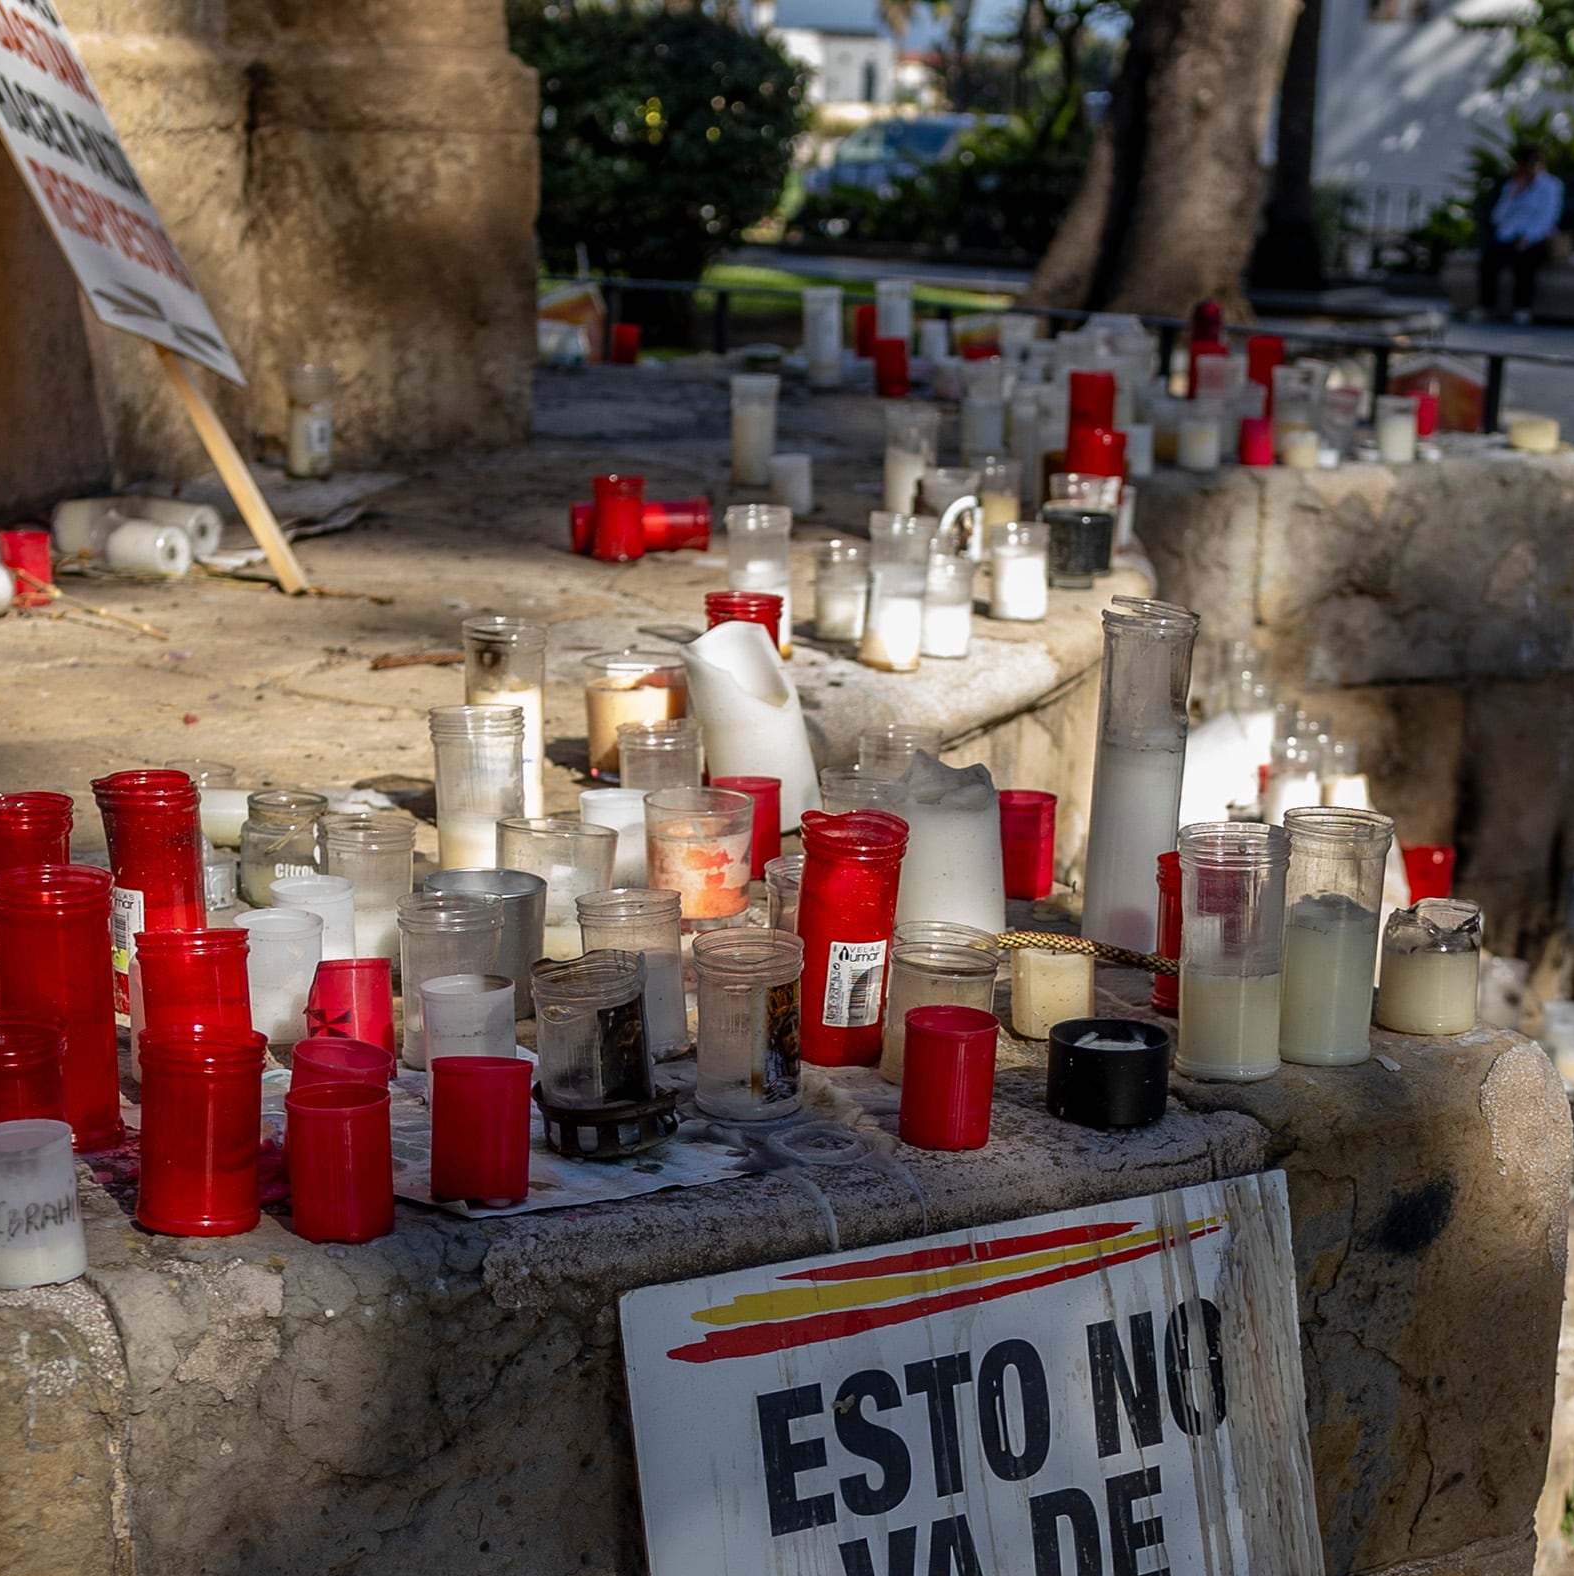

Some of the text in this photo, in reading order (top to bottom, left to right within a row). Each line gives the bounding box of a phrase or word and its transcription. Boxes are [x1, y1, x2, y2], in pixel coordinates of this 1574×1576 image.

[849, 945, 881, 953] VELAS
[759, 1297, 1227, 1538] ESTO NO
